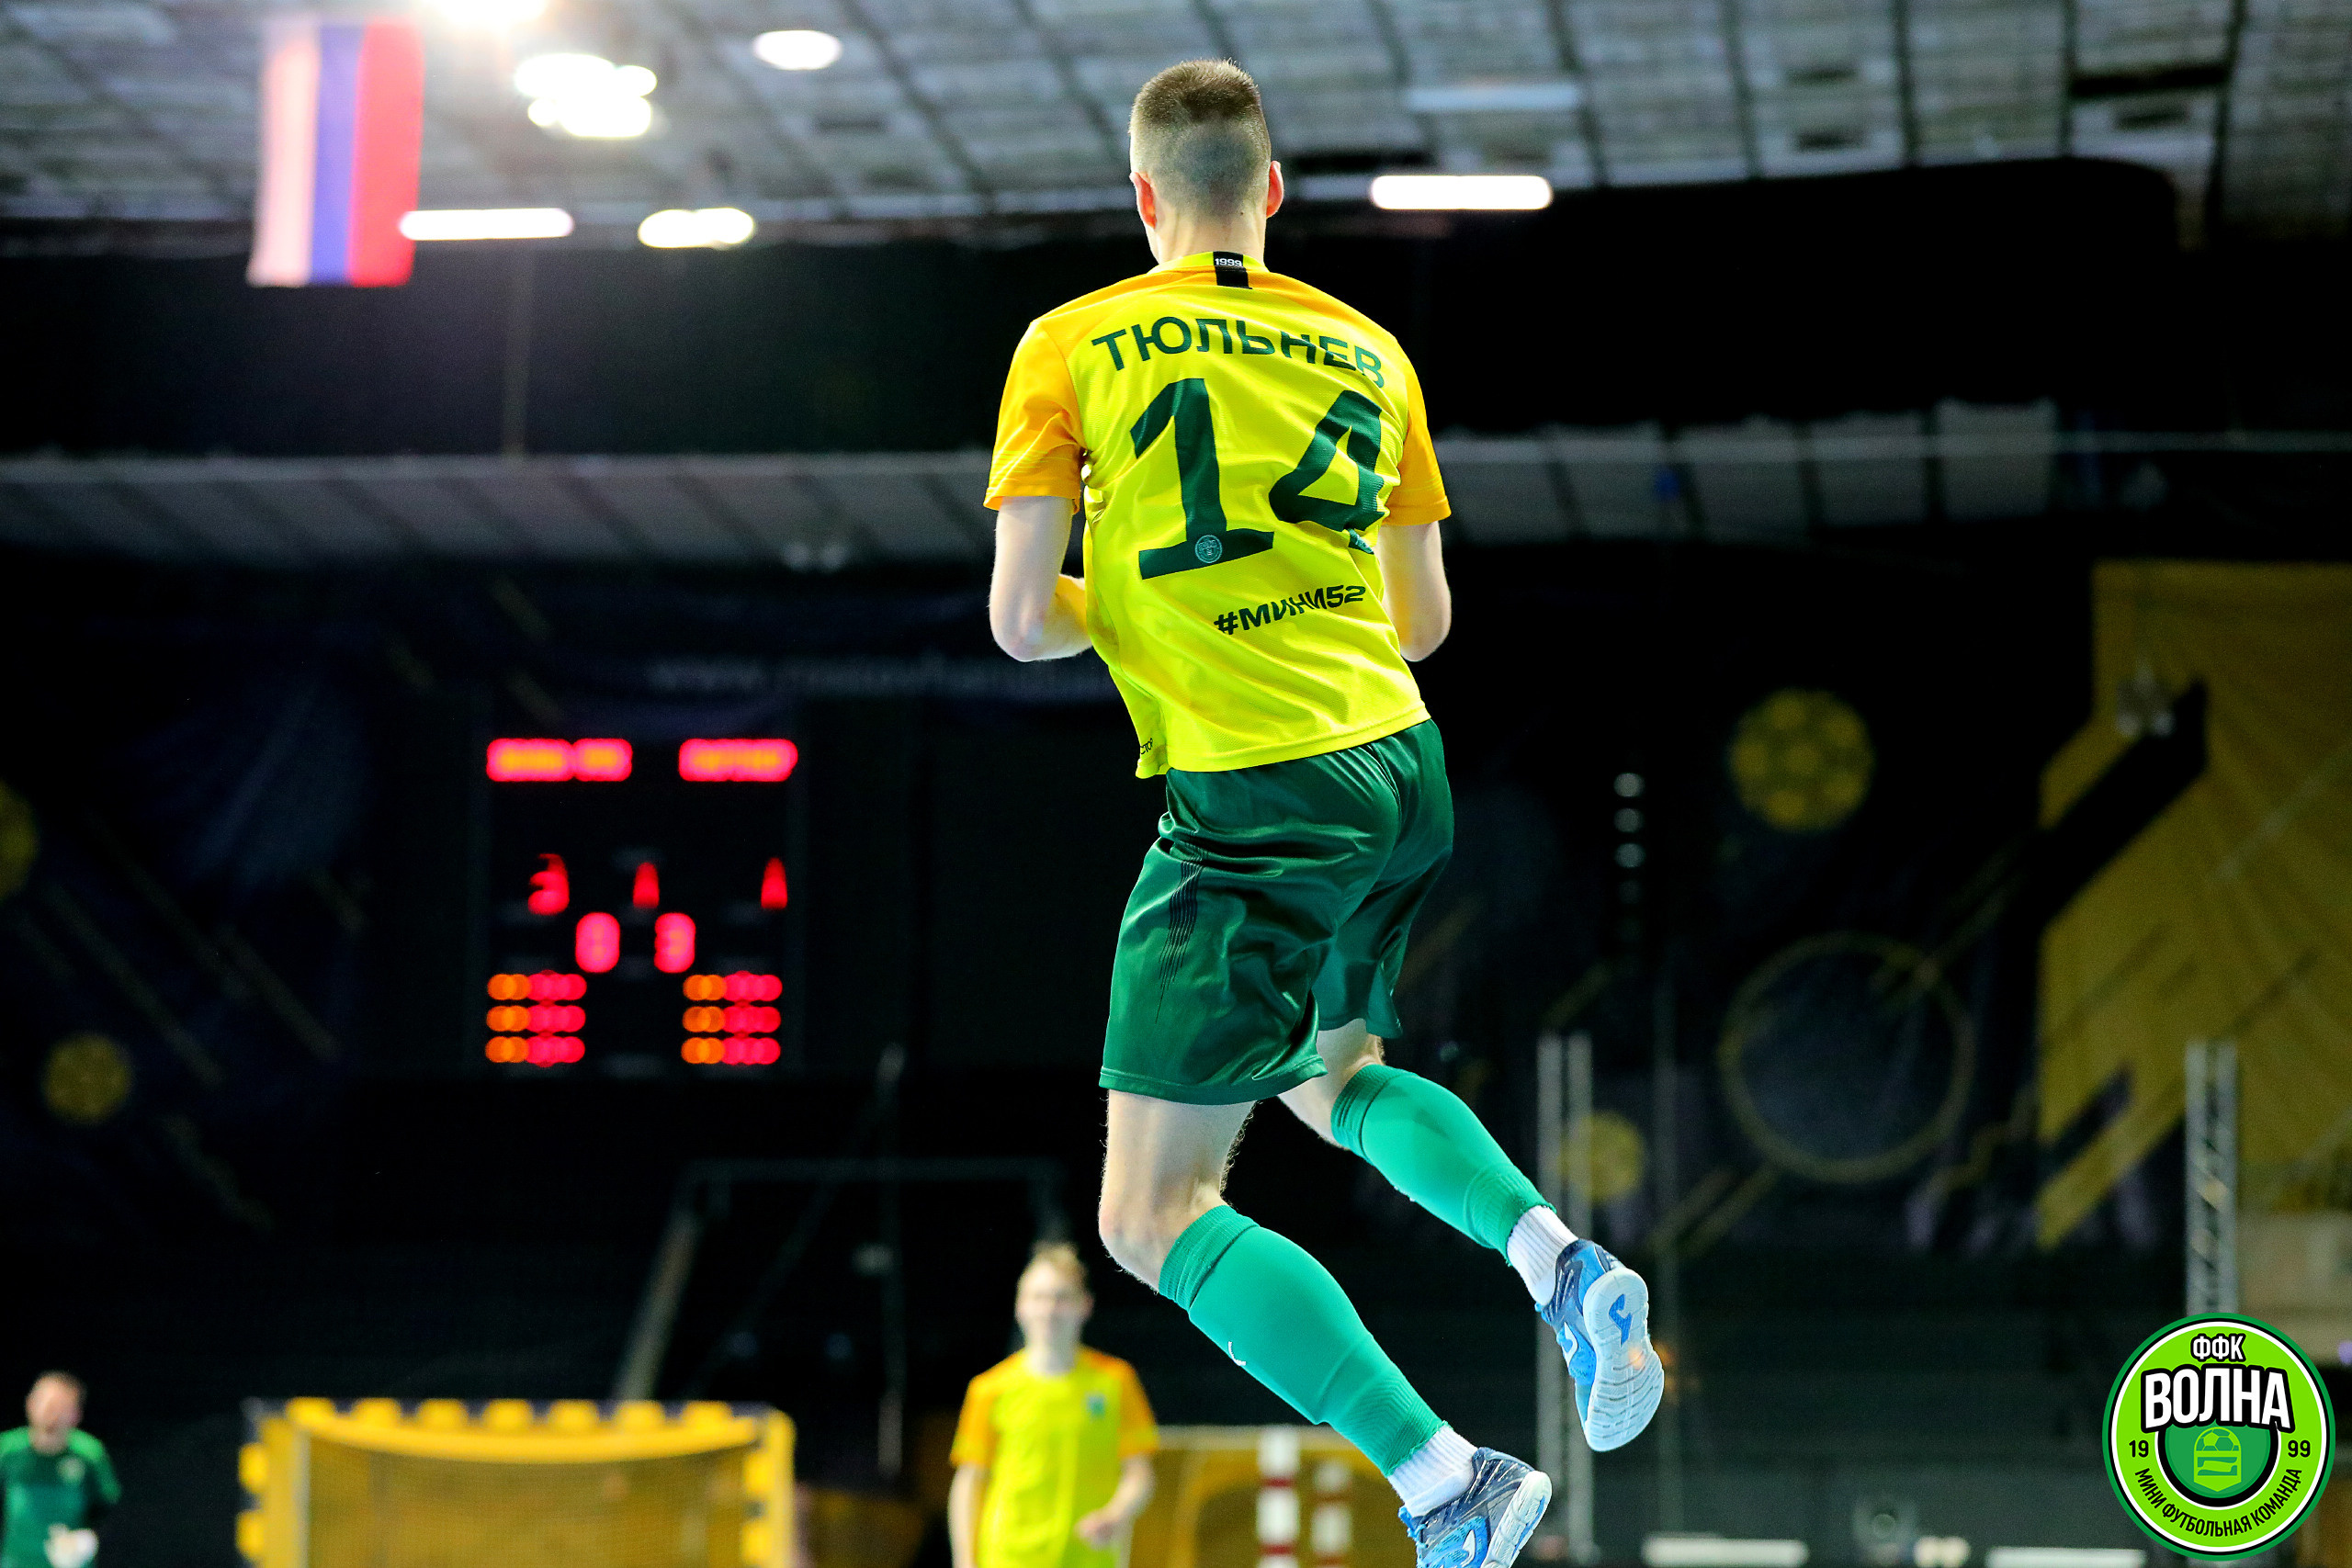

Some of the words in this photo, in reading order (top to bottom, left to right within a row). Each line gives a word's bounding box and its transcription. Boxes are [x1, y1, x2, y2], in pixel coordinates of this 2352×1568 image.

[1215, 258, 1243, 267] 1999
[1091, 315, 1385, 389] ТЮЛЬНЕВ
[1130, 378, 1385, 581] 14
[1214, 584, 1366, 635] #МИНИ52
